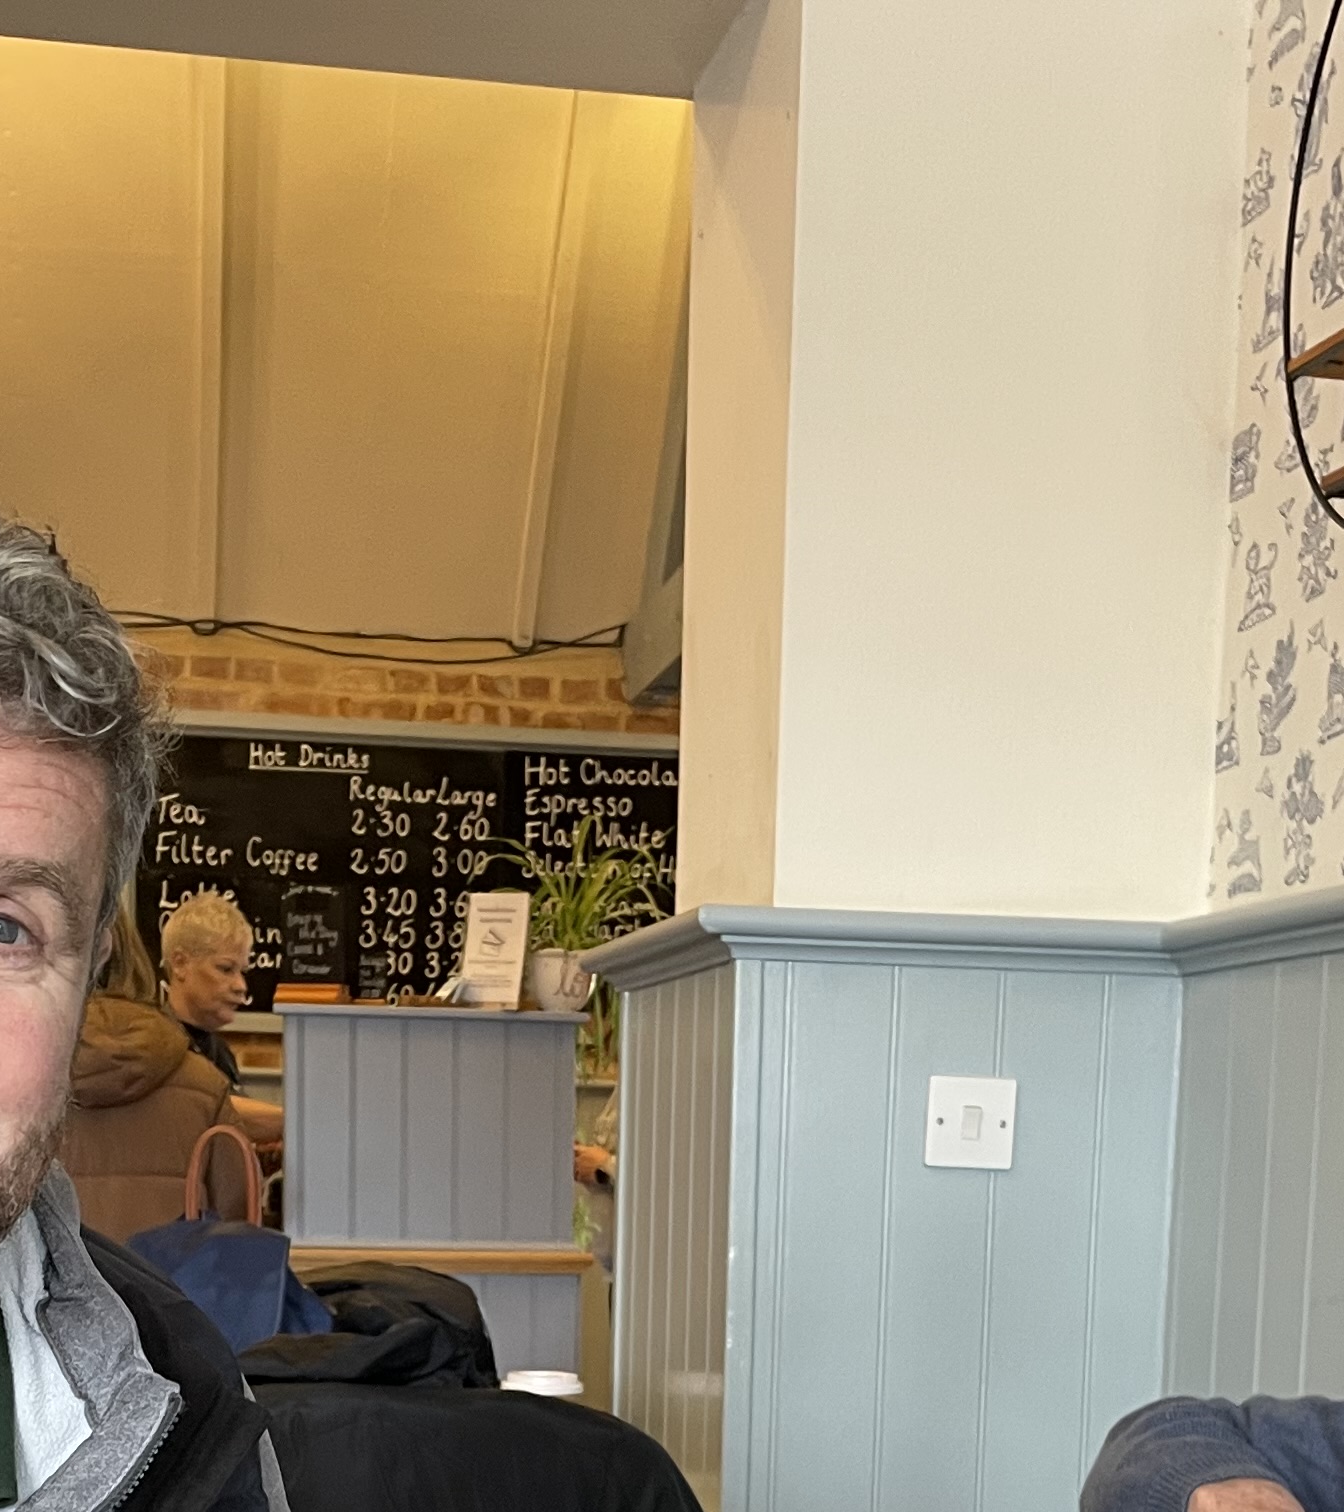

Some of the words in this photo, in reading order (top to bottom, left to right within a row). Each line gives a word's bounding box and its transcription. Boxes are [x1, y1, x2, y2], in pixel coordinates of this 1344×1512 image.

[249, 742, 287, 767] Hot
[298, 744, 370, 769] Drinks
[524, 756, 571, 786] Hot
[579, 758, 678, 786] Chocola
[158, 793, 206, 825] Tea
[349, 776, 437, 812] Regular
[435, 776, 498, 820] Large
[524, 788, 634, 827] Espresso
[524, 821, 581, 848] Flat
[594, 821, 667, 849] White
[156, 831, 233, 866] Filter
[246, 836, 319, 876] Coffee
[429, 887, 469, 918] 3.6
[424, 920, 466, 950] 3.8
